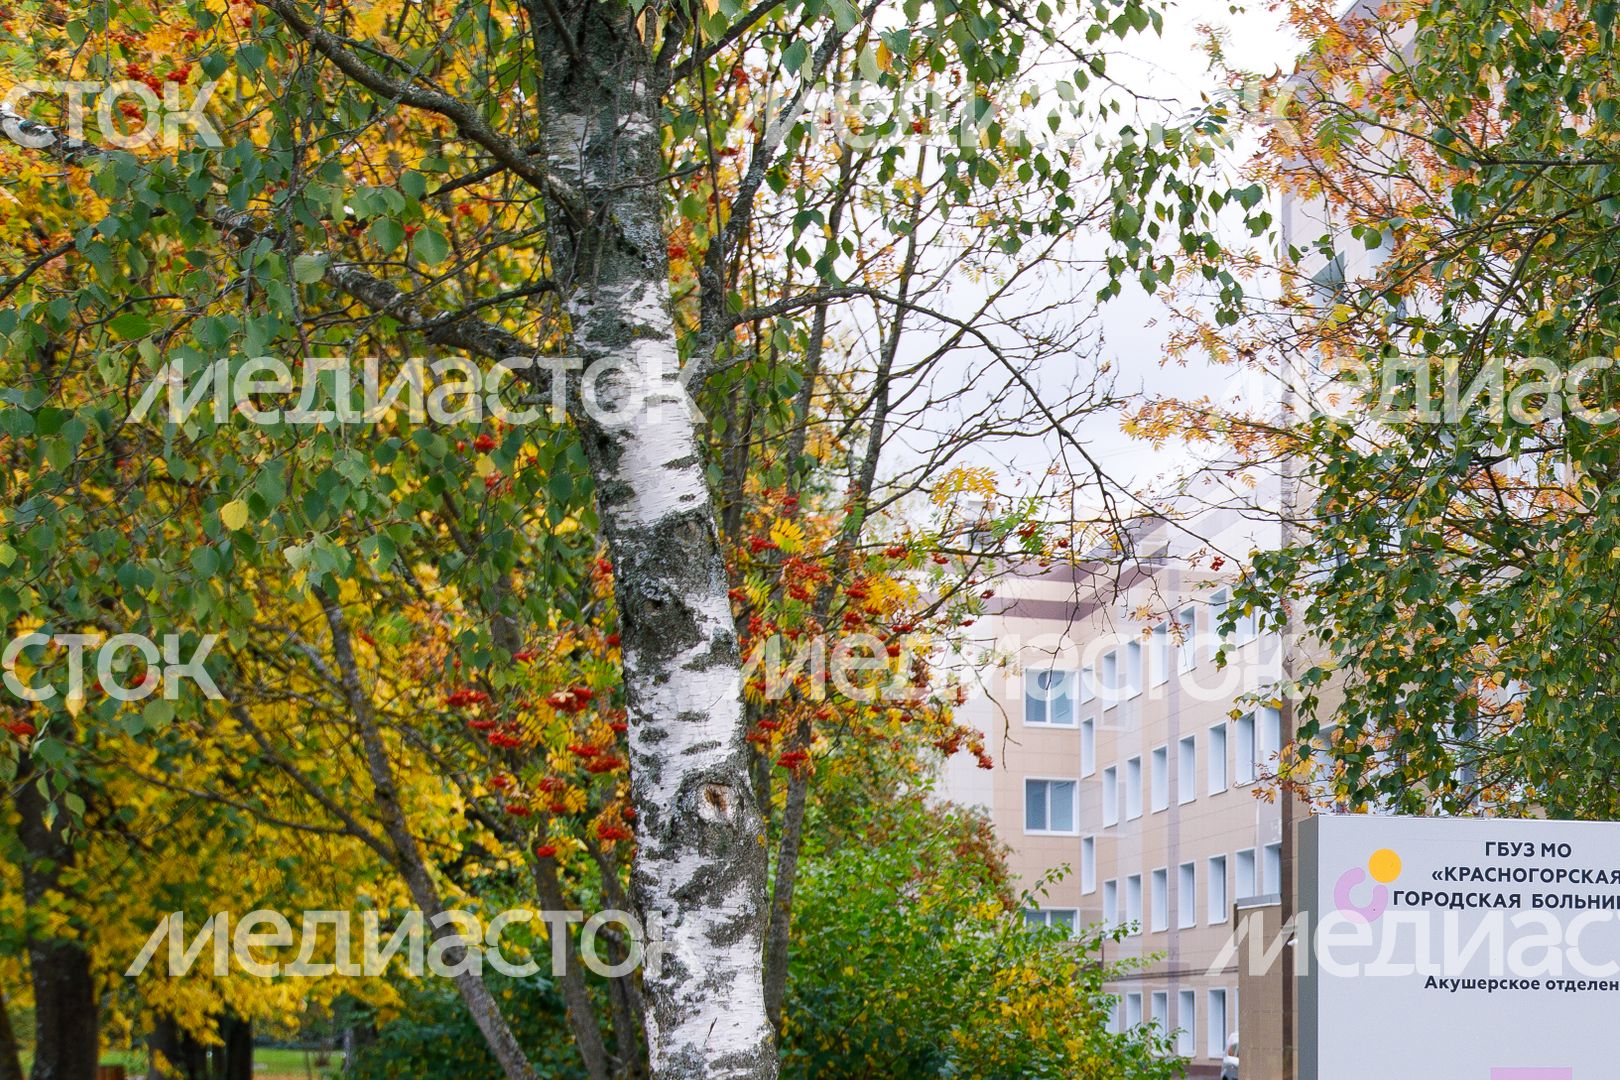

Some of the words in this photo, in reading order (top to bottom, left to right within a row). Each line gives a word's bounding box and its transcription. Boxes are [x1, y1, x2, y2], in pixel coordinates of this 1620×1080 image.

[1485, 841, 1536, 858] ГБУЗ
[1541, 842, 1572, 858] МО
[1393, 890, 1521, 910] ГОРОДСКАЯ
[1423, 975, 1541, 993] Акушерское
